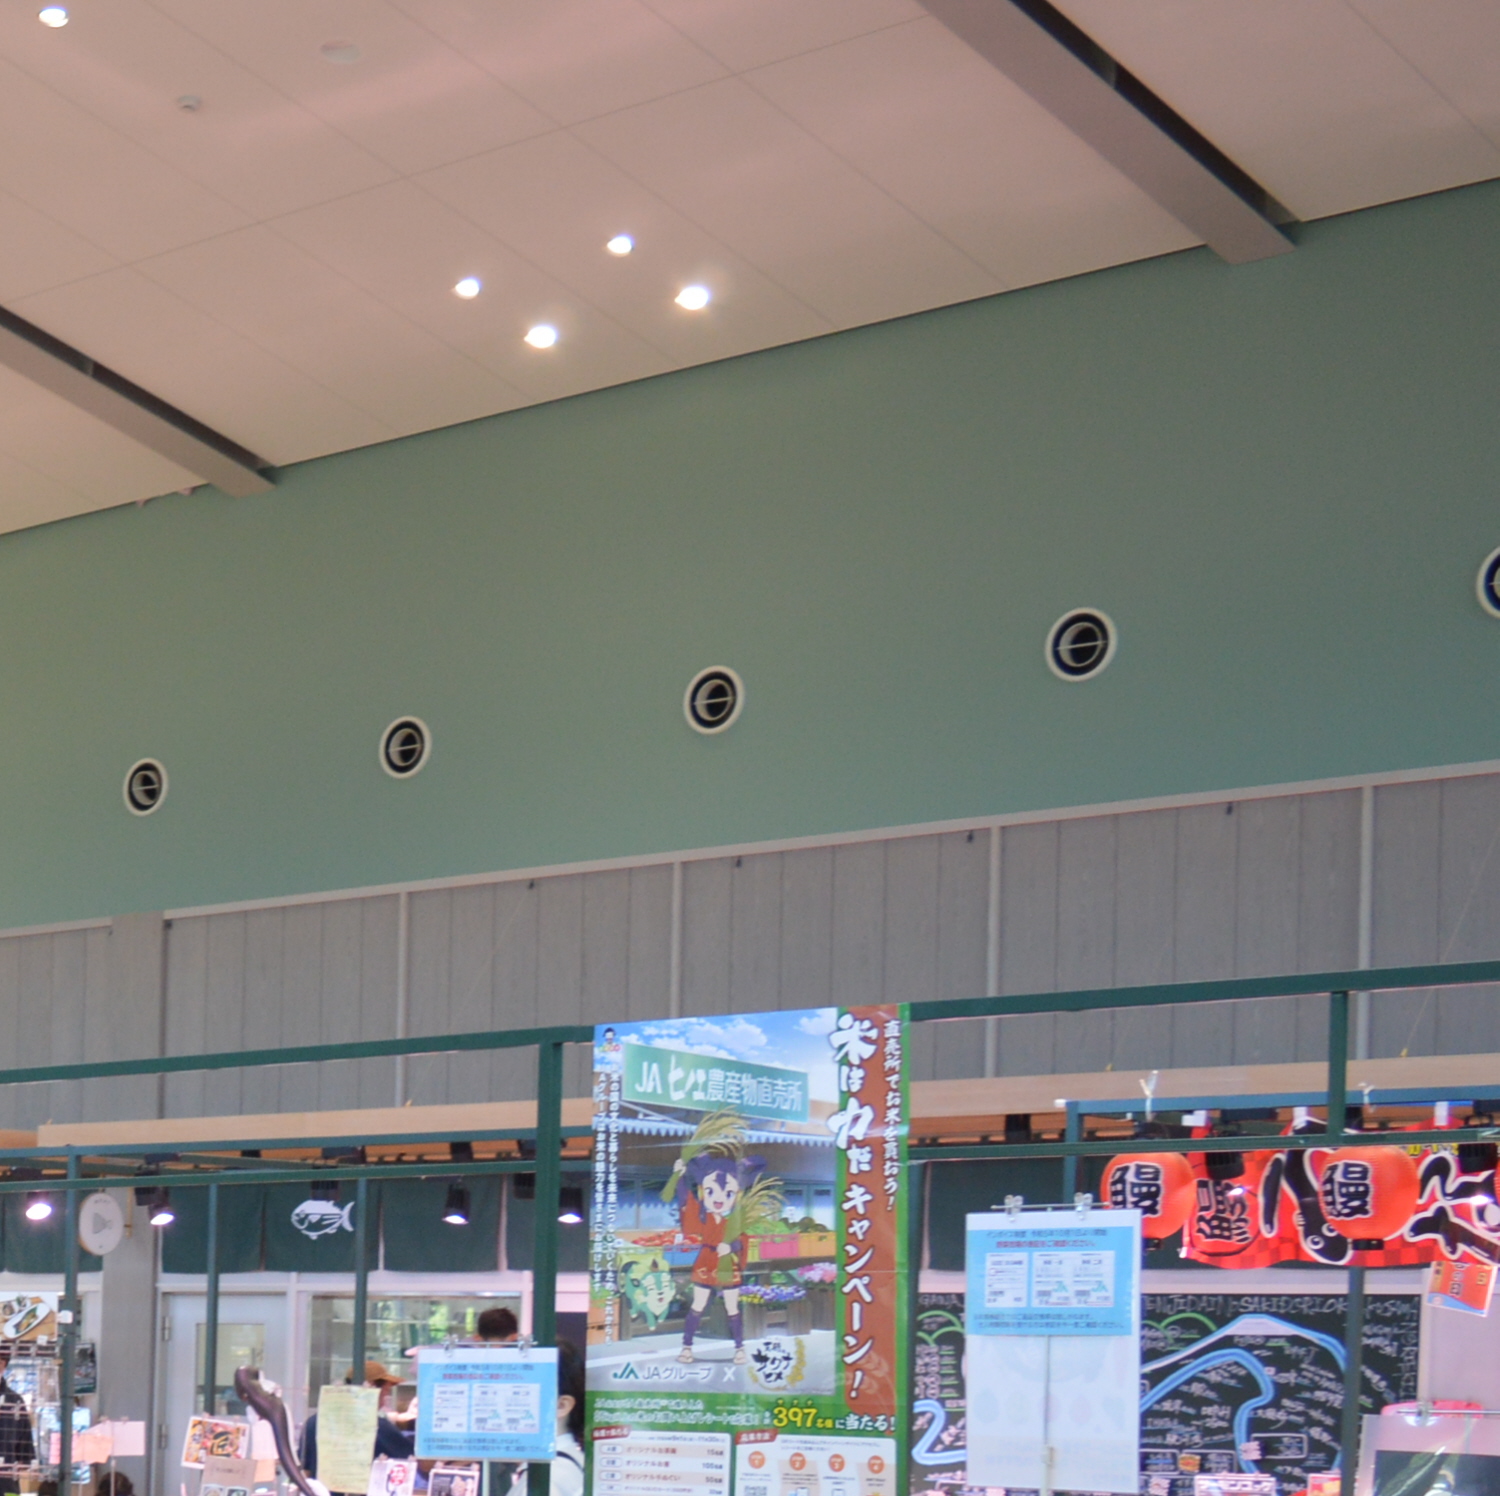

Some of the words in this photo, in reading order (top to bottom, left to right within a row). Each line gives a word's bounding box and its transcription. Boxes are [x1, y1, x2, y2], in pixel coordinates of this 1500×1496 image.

[635, 1061, 663, 1095] JA
[642, 1366, 712, 1381] JAグループ
